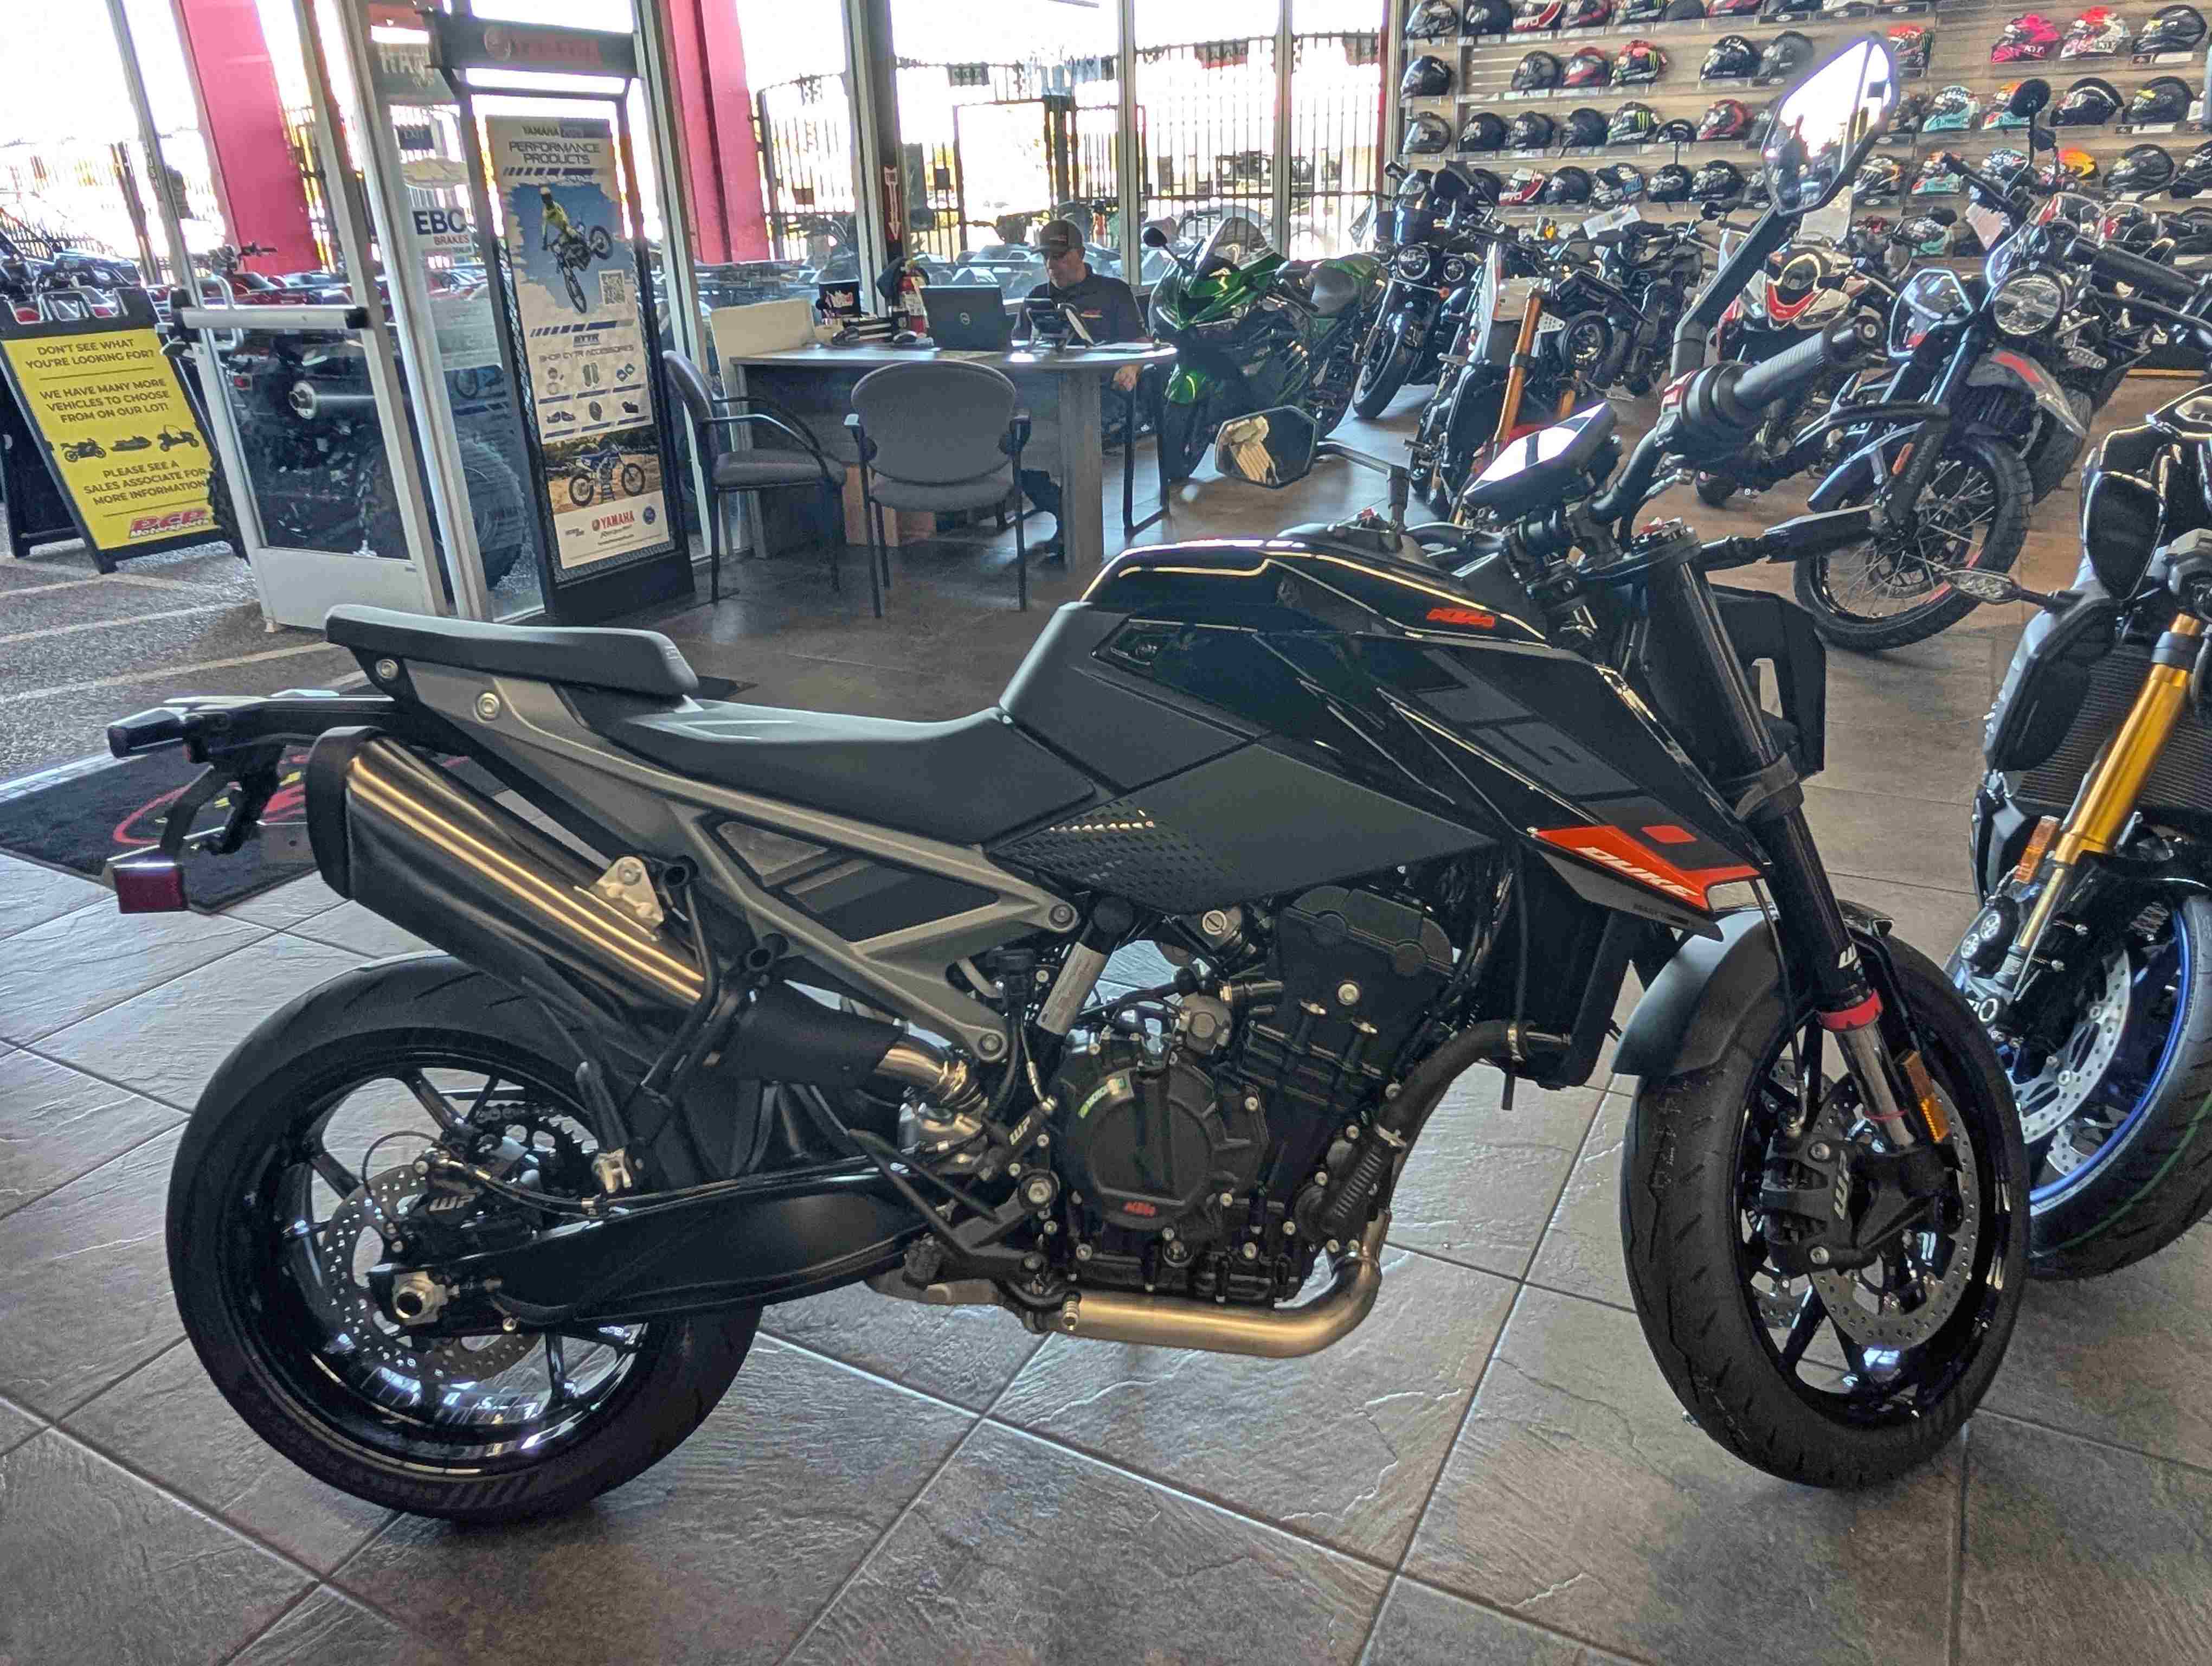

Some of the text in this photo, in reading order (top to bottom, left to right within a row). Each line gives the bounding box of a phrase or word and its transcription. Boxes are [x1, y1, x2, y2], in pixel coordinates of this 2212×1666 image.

[522, 125, 560, 136] YAMAHA
[509, 141, 601, 153] PERFORMANCE
[523, 153, 590, 164] PRODUCTS
[413, 209, 467, 234] EBC
[434, 234, 469, 246] BRAKES
[37, 338, 135, 355] DON'T SEE WHAT
[25, 349, 154, 369] YOU'RE LOOKING FOR?
[40, 378, 166, 400] WE HAVE MANY MORE
[47, 390, 170, 412] VEHICLES TO CHOOSE
[61, 402, 169, 423] FROM ON OUR LOT!
[102, 460, 179, 478] PLEASE SEE A
[83, 468, 207, 494] SALES ASSOCIATE FOR
[93, 480, 206, 505] MORE INFORMATION
[601, 510, 635, 529] YAMAHA
[1426, 607, 1495, 629] KTM
[1574, 846, 1700, 898] DUKE
[429, 1194, 475, 1212] WP
